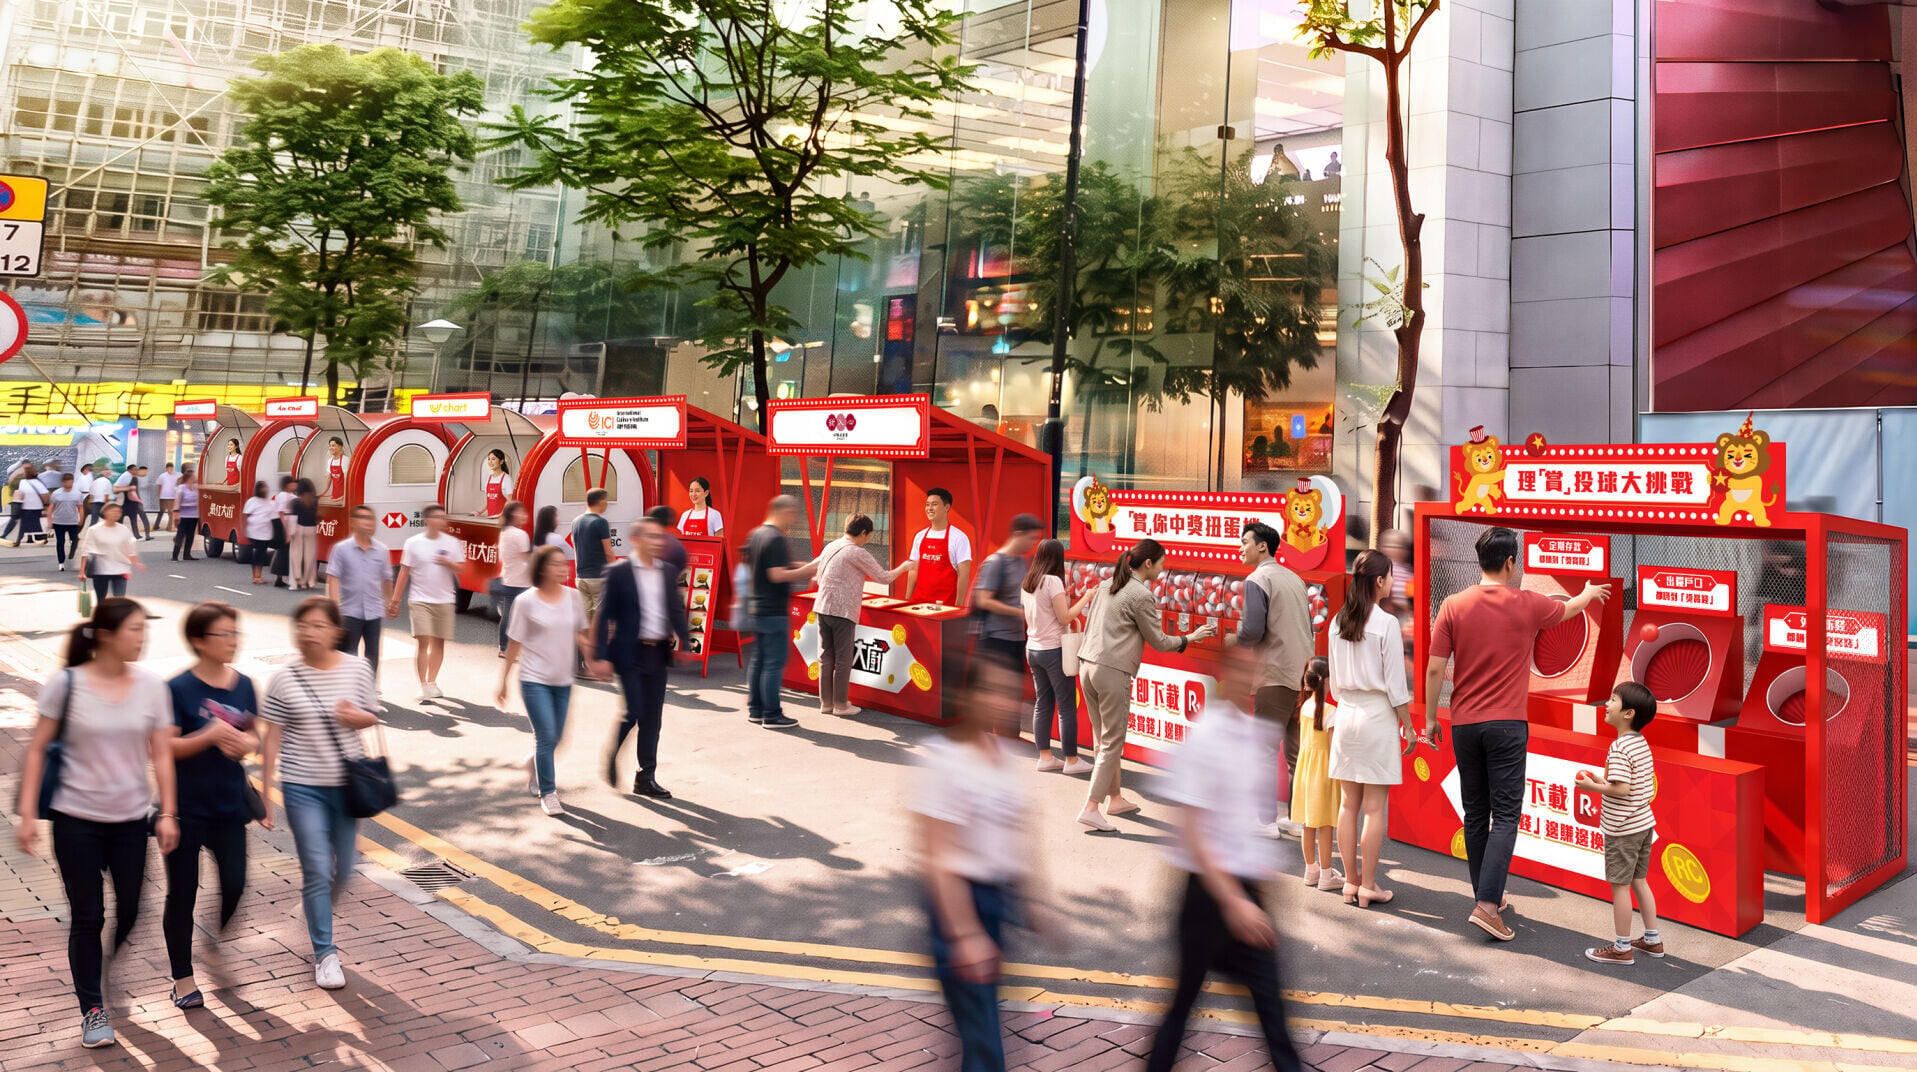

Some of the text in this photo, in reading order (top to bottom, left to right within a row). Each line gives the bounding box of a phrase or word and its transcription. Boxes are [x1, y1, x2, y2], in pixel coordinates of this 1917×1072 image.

[4, 224, 19, 240] 7
[1, 255, 30, 271] 12
[1518, 468, 1693, 496] 理「賞」投球大挑戰
[913, 667, 929, 682] RC
[1672, 854, 1704, 885] RC
